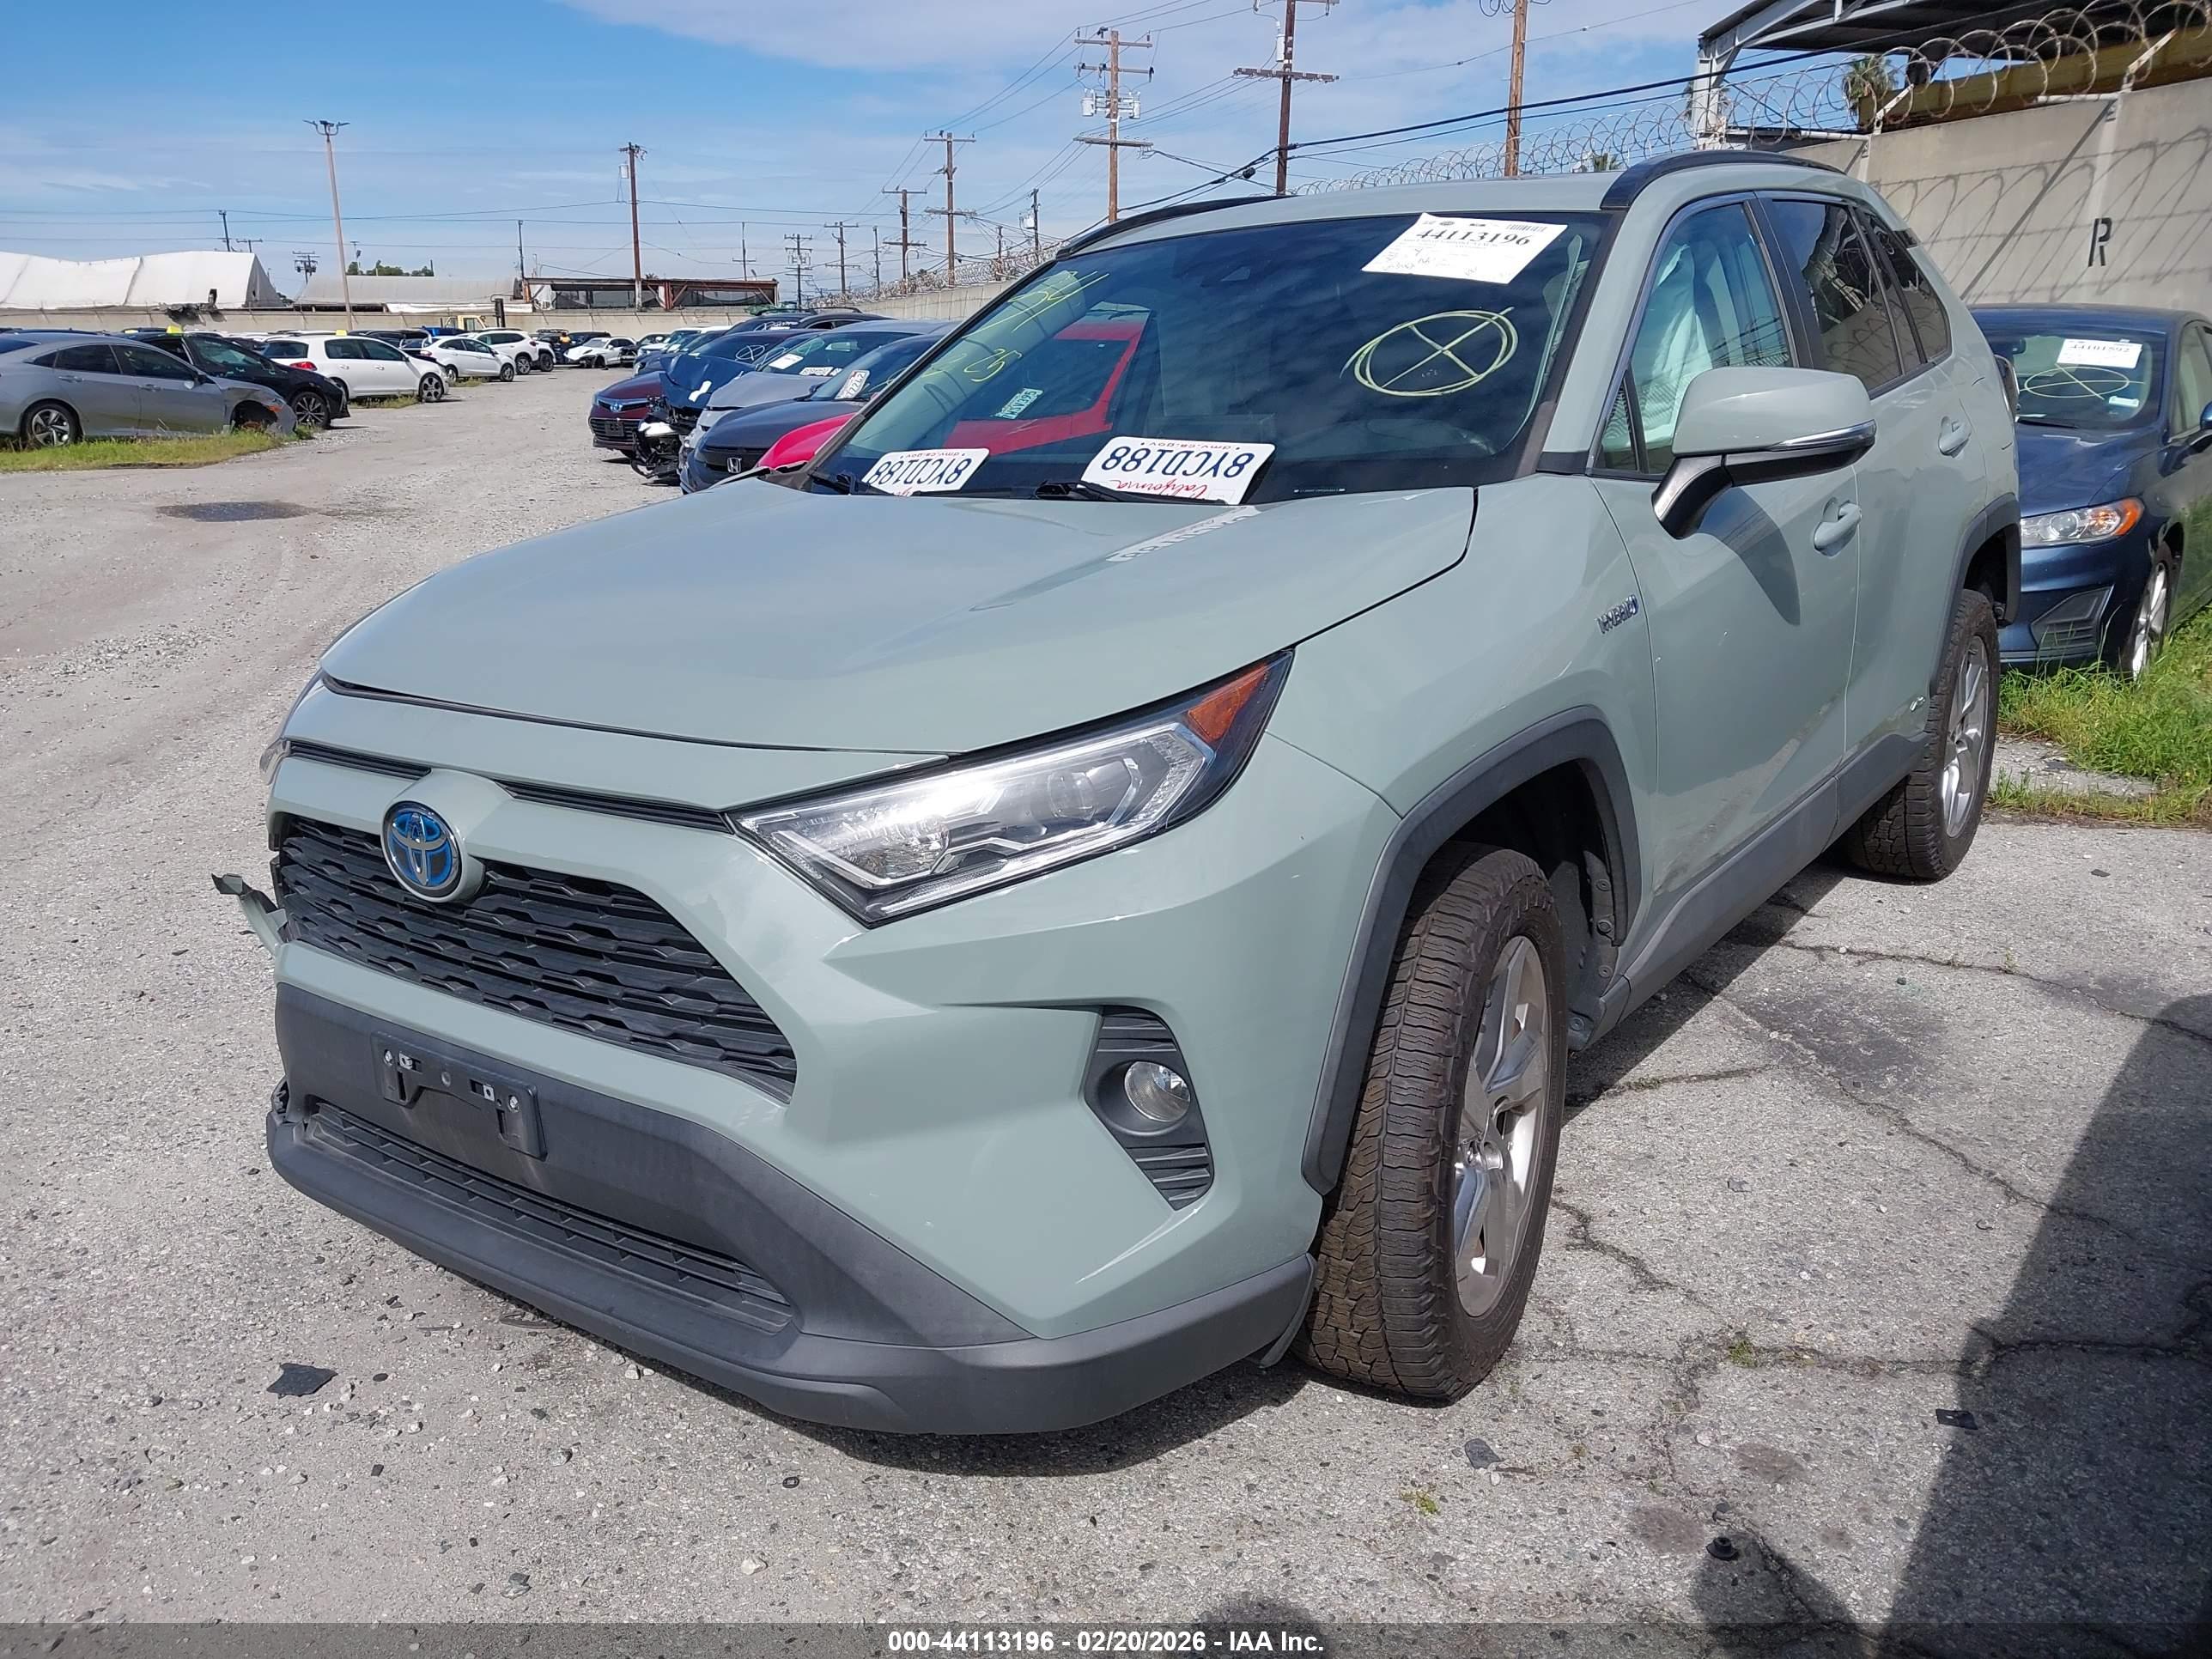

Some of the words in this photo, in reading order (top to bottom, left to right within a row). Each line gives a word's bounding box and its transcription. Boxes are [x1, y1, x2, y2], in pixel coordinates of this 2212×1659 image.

[1416, 228, 1534, 246] 44113196
[2087, 217, 2112, 267] R
[868, 458, 972, 485] 8YCD188
[1101, 446, 1255, 478] 8YCD188
[1597, 593, 1638, 635] HYBRID
